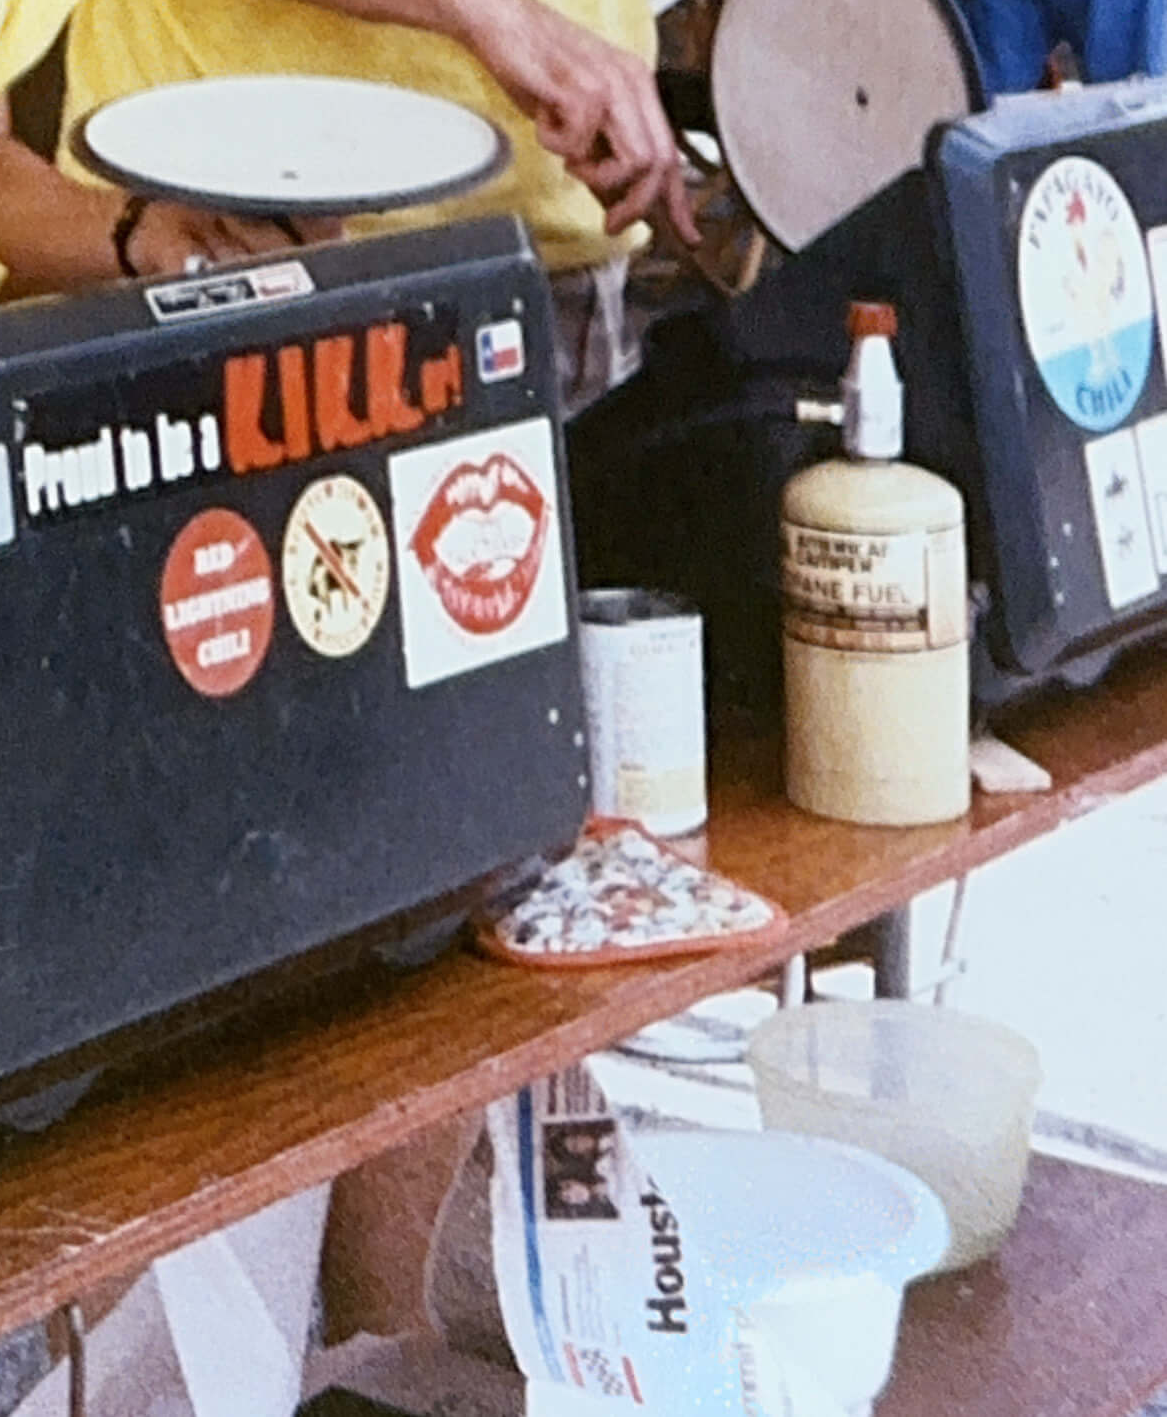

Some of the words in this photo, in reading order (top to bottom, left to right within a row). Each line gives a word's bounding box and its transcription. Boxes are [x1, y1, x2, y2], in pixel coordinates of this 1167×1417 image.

[1074, 367, 1134, 418] CHILI
[852, 580, 911, 604] FUEL
[640, 1175, 687, 1335] Houst
